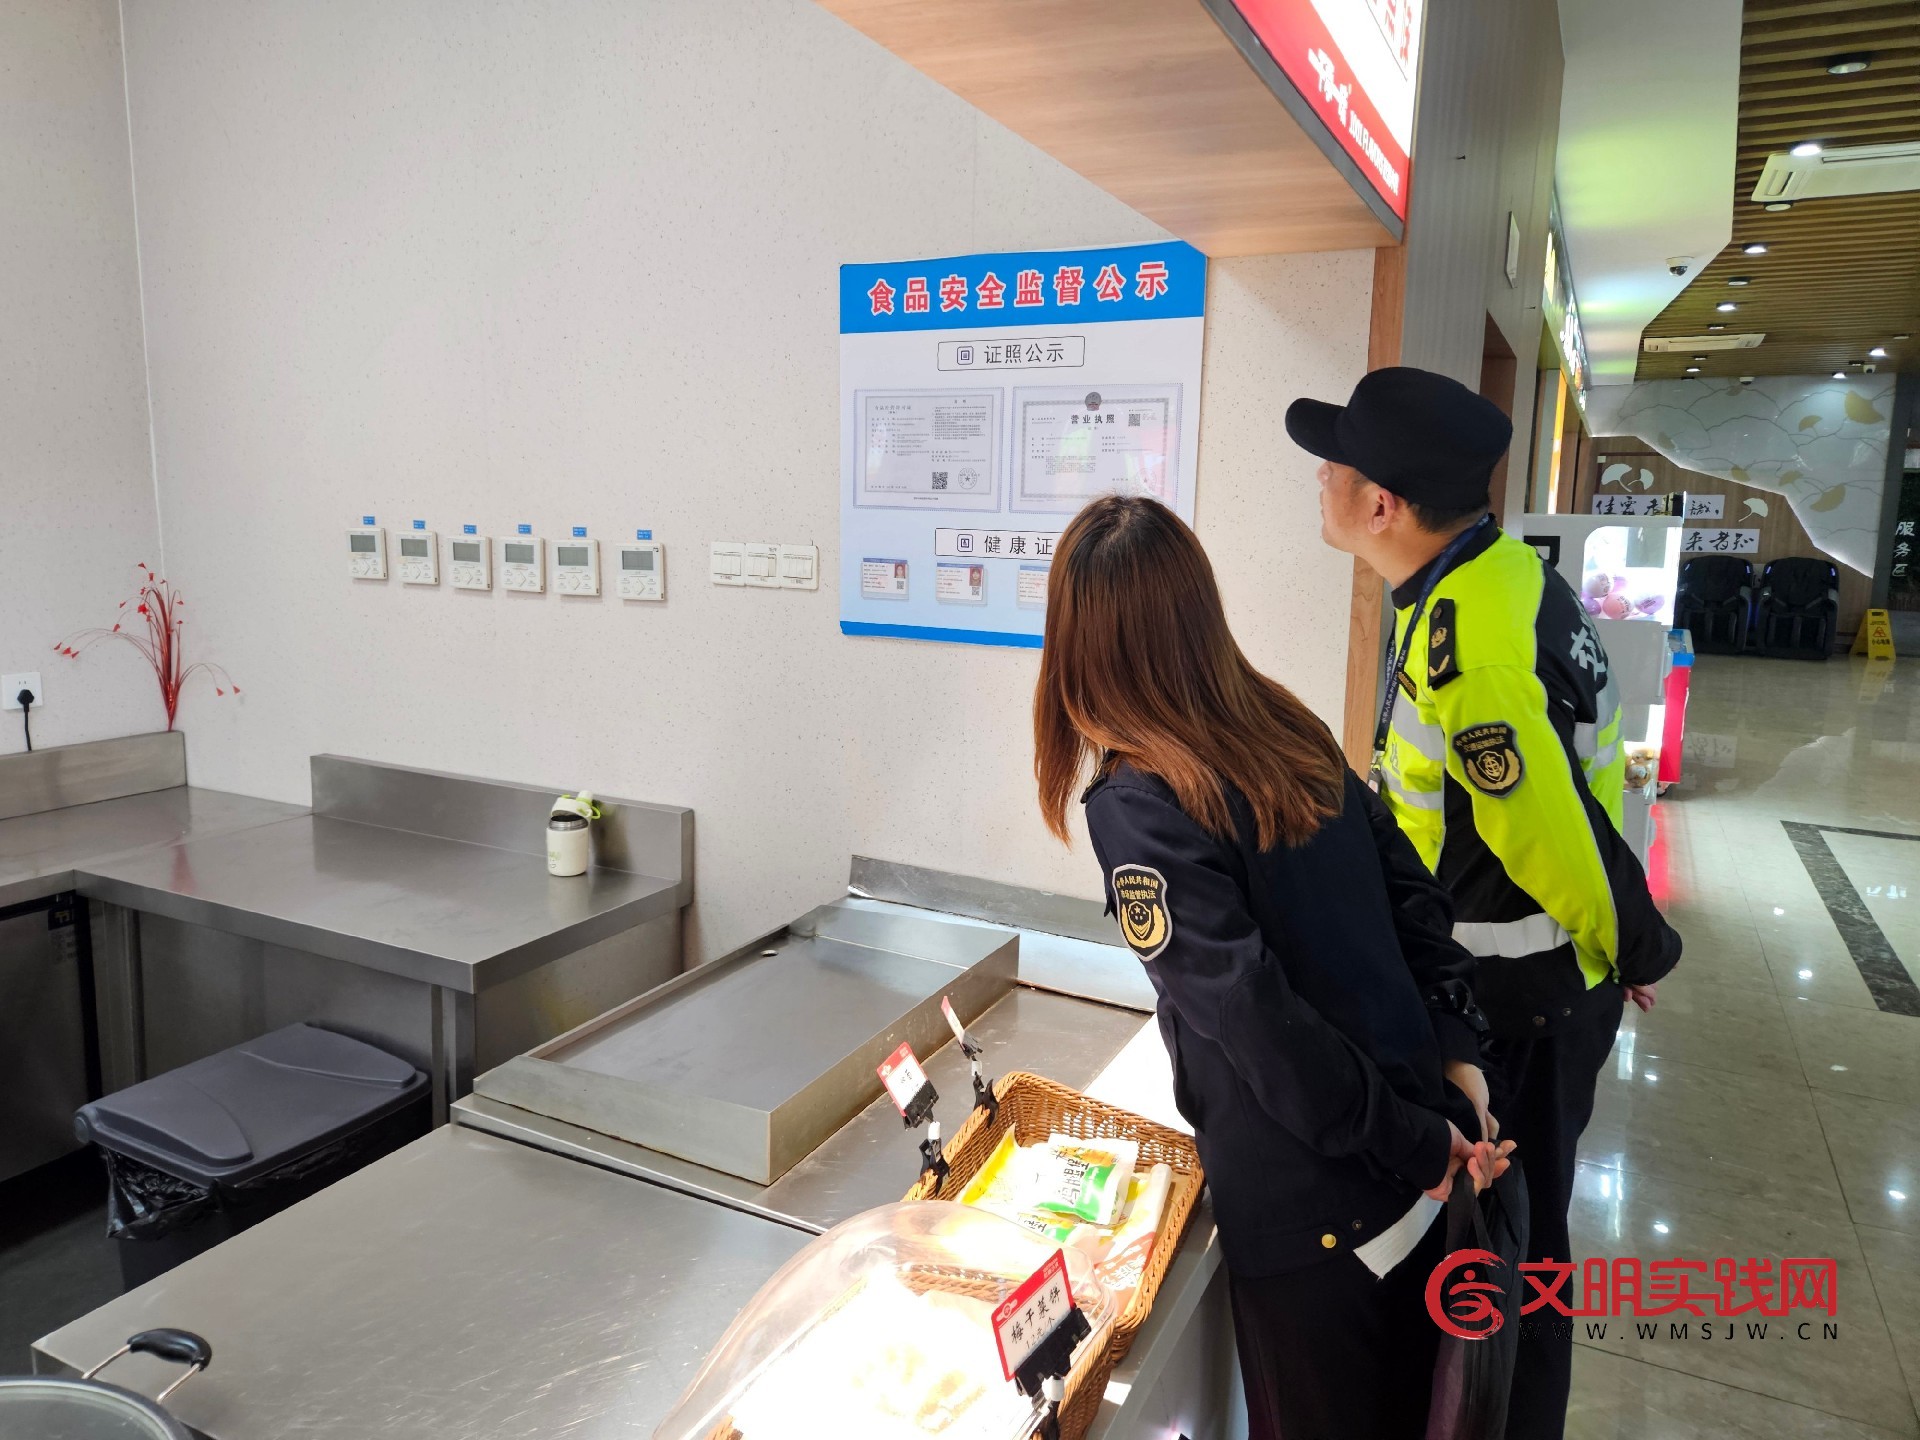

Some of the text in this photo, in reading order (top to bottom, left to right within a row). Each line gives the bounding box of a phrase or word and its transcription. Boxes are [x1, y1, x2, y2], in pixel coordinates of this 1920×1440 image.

[868, 261, 1168, 315] 食品安全监督公示
[984, 343, 1064, 364] 证照公示
[1070, 414, 1115, 424] 营业执照
[984, 535, 1053, 555] 健康证
[1892, 521, 1916, 577] 服务区
[1116, 875, 1158, 889] 中华人民共和国
[1120, 889, 1157, 899] 市场监管执法
